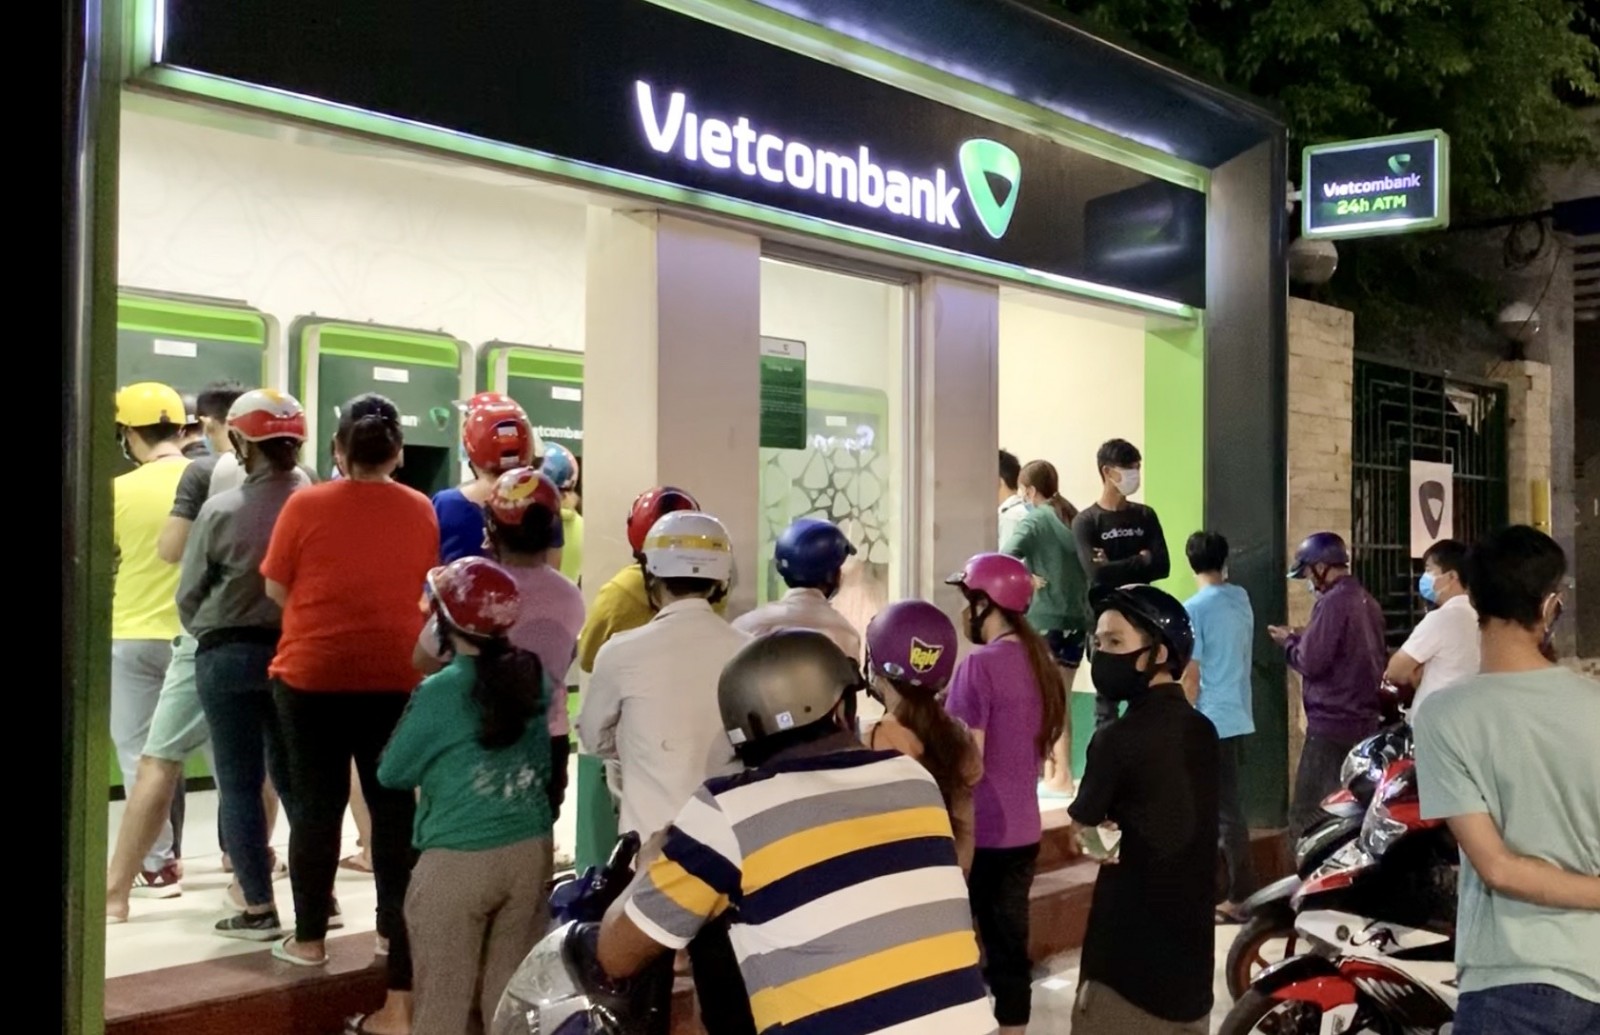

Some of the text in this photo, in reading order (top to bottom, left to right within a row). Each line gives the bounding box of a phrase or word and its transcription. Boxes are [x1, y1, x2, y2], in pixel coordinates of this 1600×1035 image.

[636, 80, 960, 228] Vietcombank
[1324, 173, 1420, 197] Vietcombank
[1337, 194, 1407, 215] 24h ATM
[1101, 528, 1134, 540] adidas
